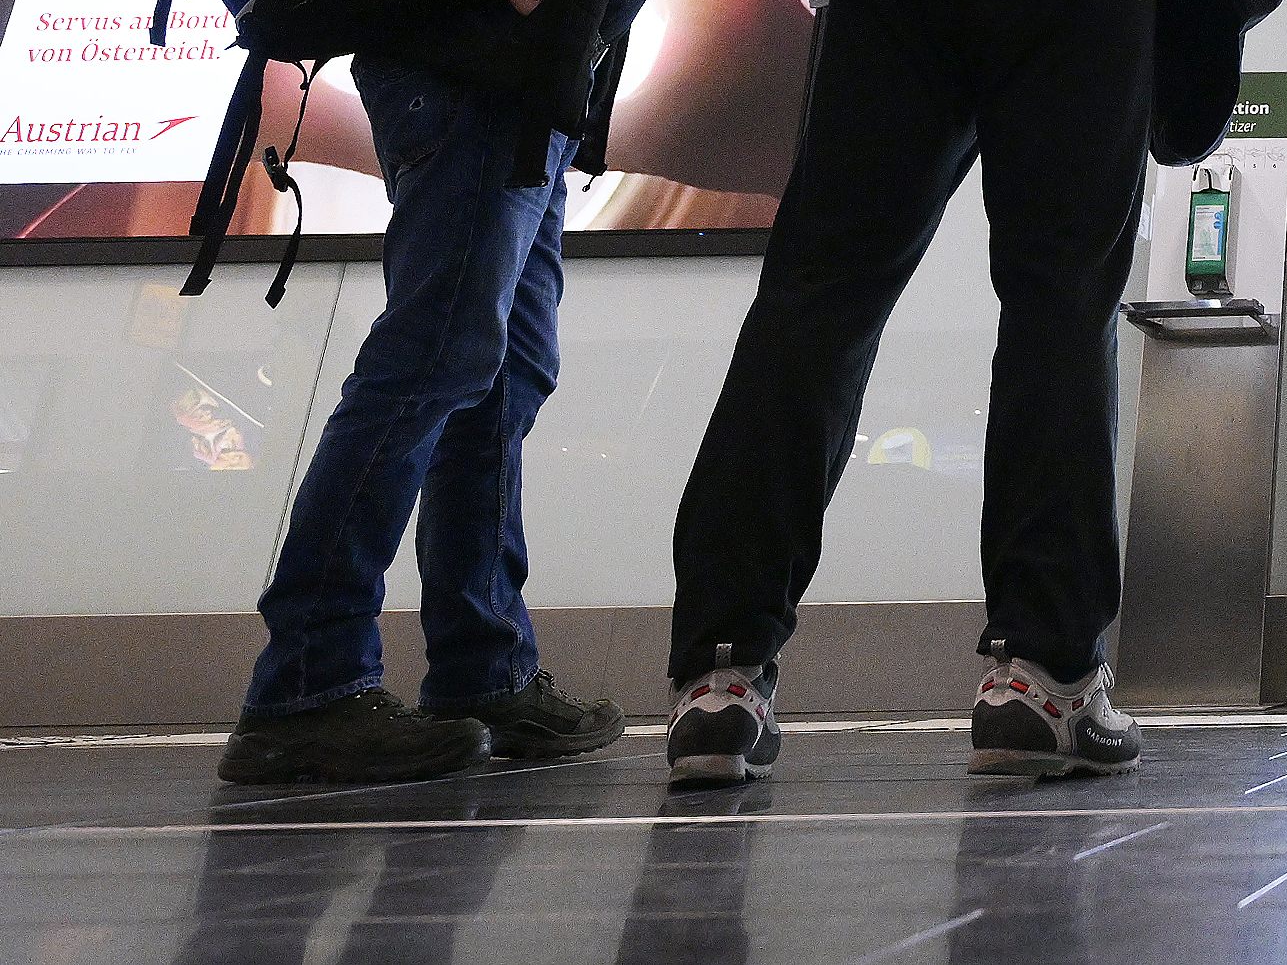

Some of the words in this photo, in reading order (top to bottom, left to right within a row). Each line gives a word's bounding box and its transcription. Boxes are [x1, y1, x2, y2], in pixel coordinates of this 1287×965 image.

[36, 12, 122, 31] Servus
[169, 10, 230, 30] Bord
[28, 48, 72, 63] von
[81, 38, 221, 63] Österreich.
[0, 115, 142, 143] Austrian
[1229, 120, 1257, 133] tizer
[17, 147, 72, 156] CHARMING
[77, 147, 98, 155] WAY
[103, 147, 115, 155] TO
[1086, 727, 1123, 746] GARMONT
